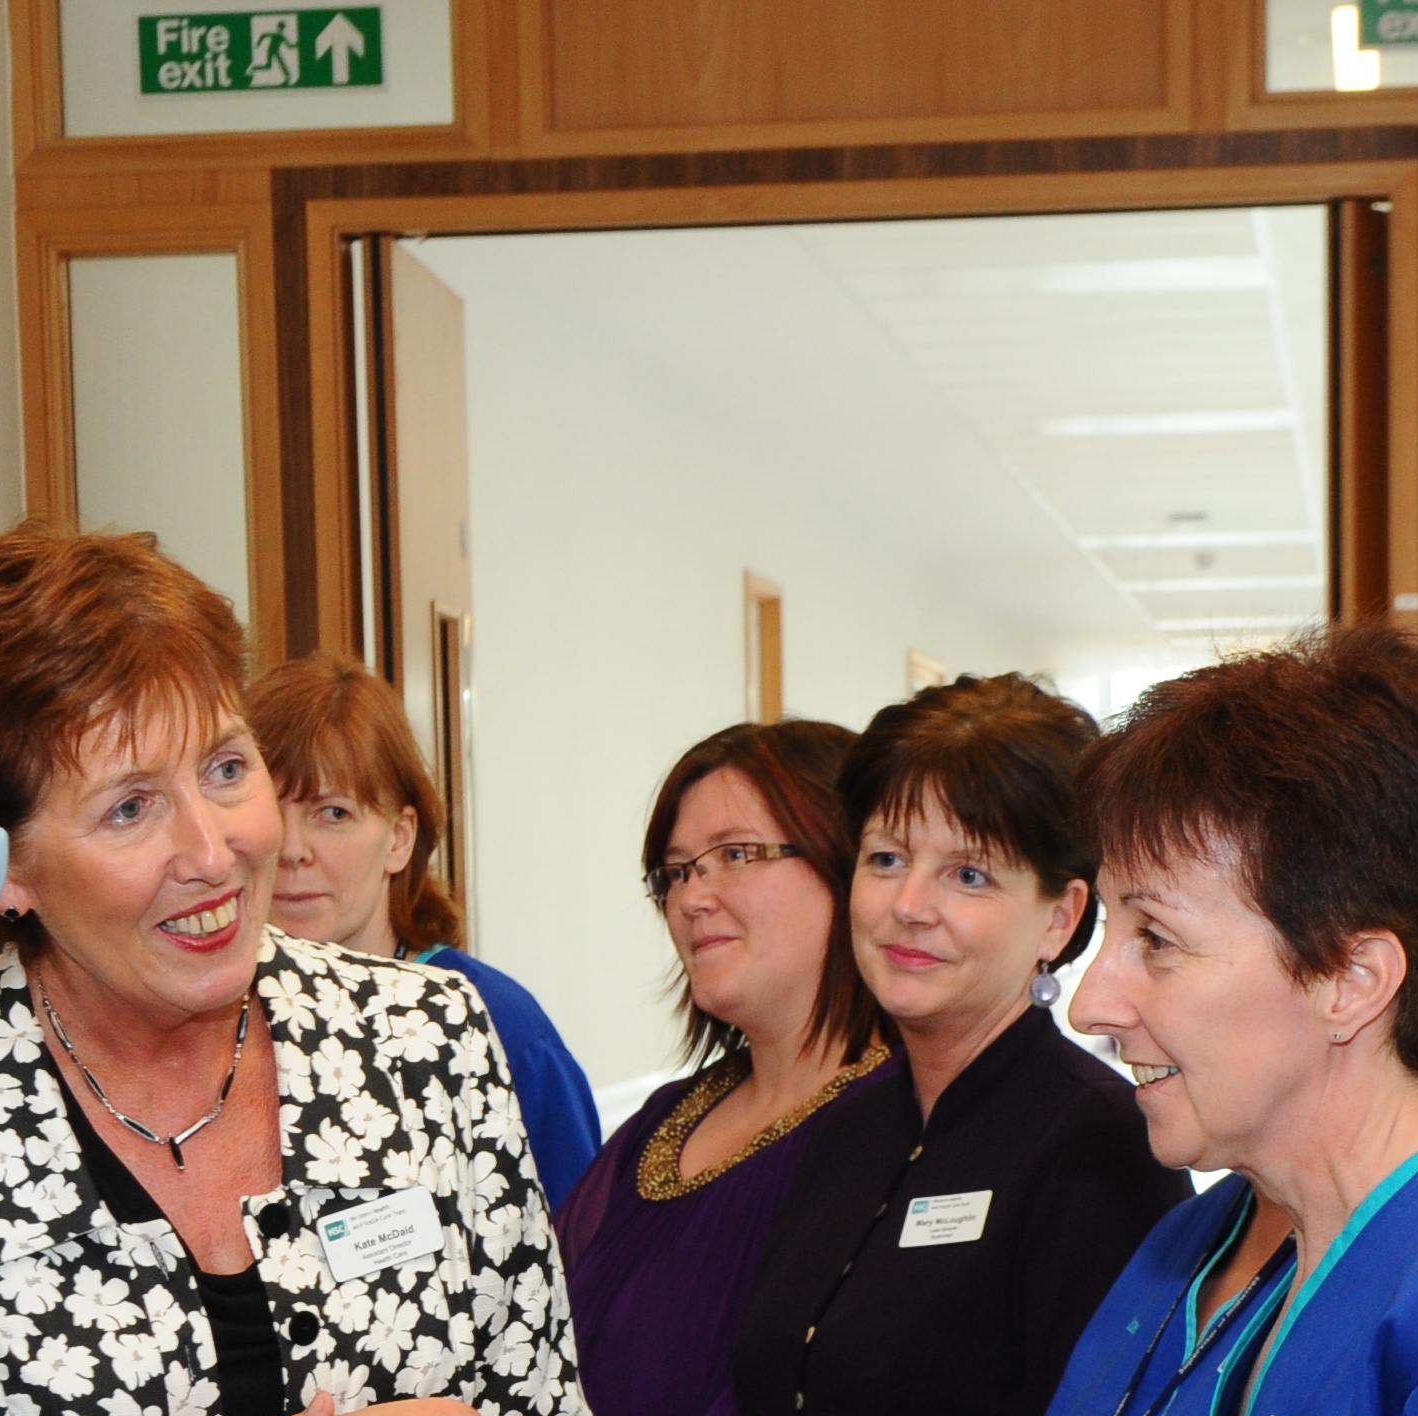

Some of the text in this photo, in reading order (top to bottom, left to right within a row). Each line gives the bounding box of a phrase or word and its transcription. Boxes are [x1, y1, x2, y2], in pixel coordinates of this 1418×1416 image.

[156, 18, 230, 55] Fire
[158, 49, 233, 90] exit
[354, 1224, 414, 1251] Kate McDaid
[389, 1240, 411, 1250] Director
